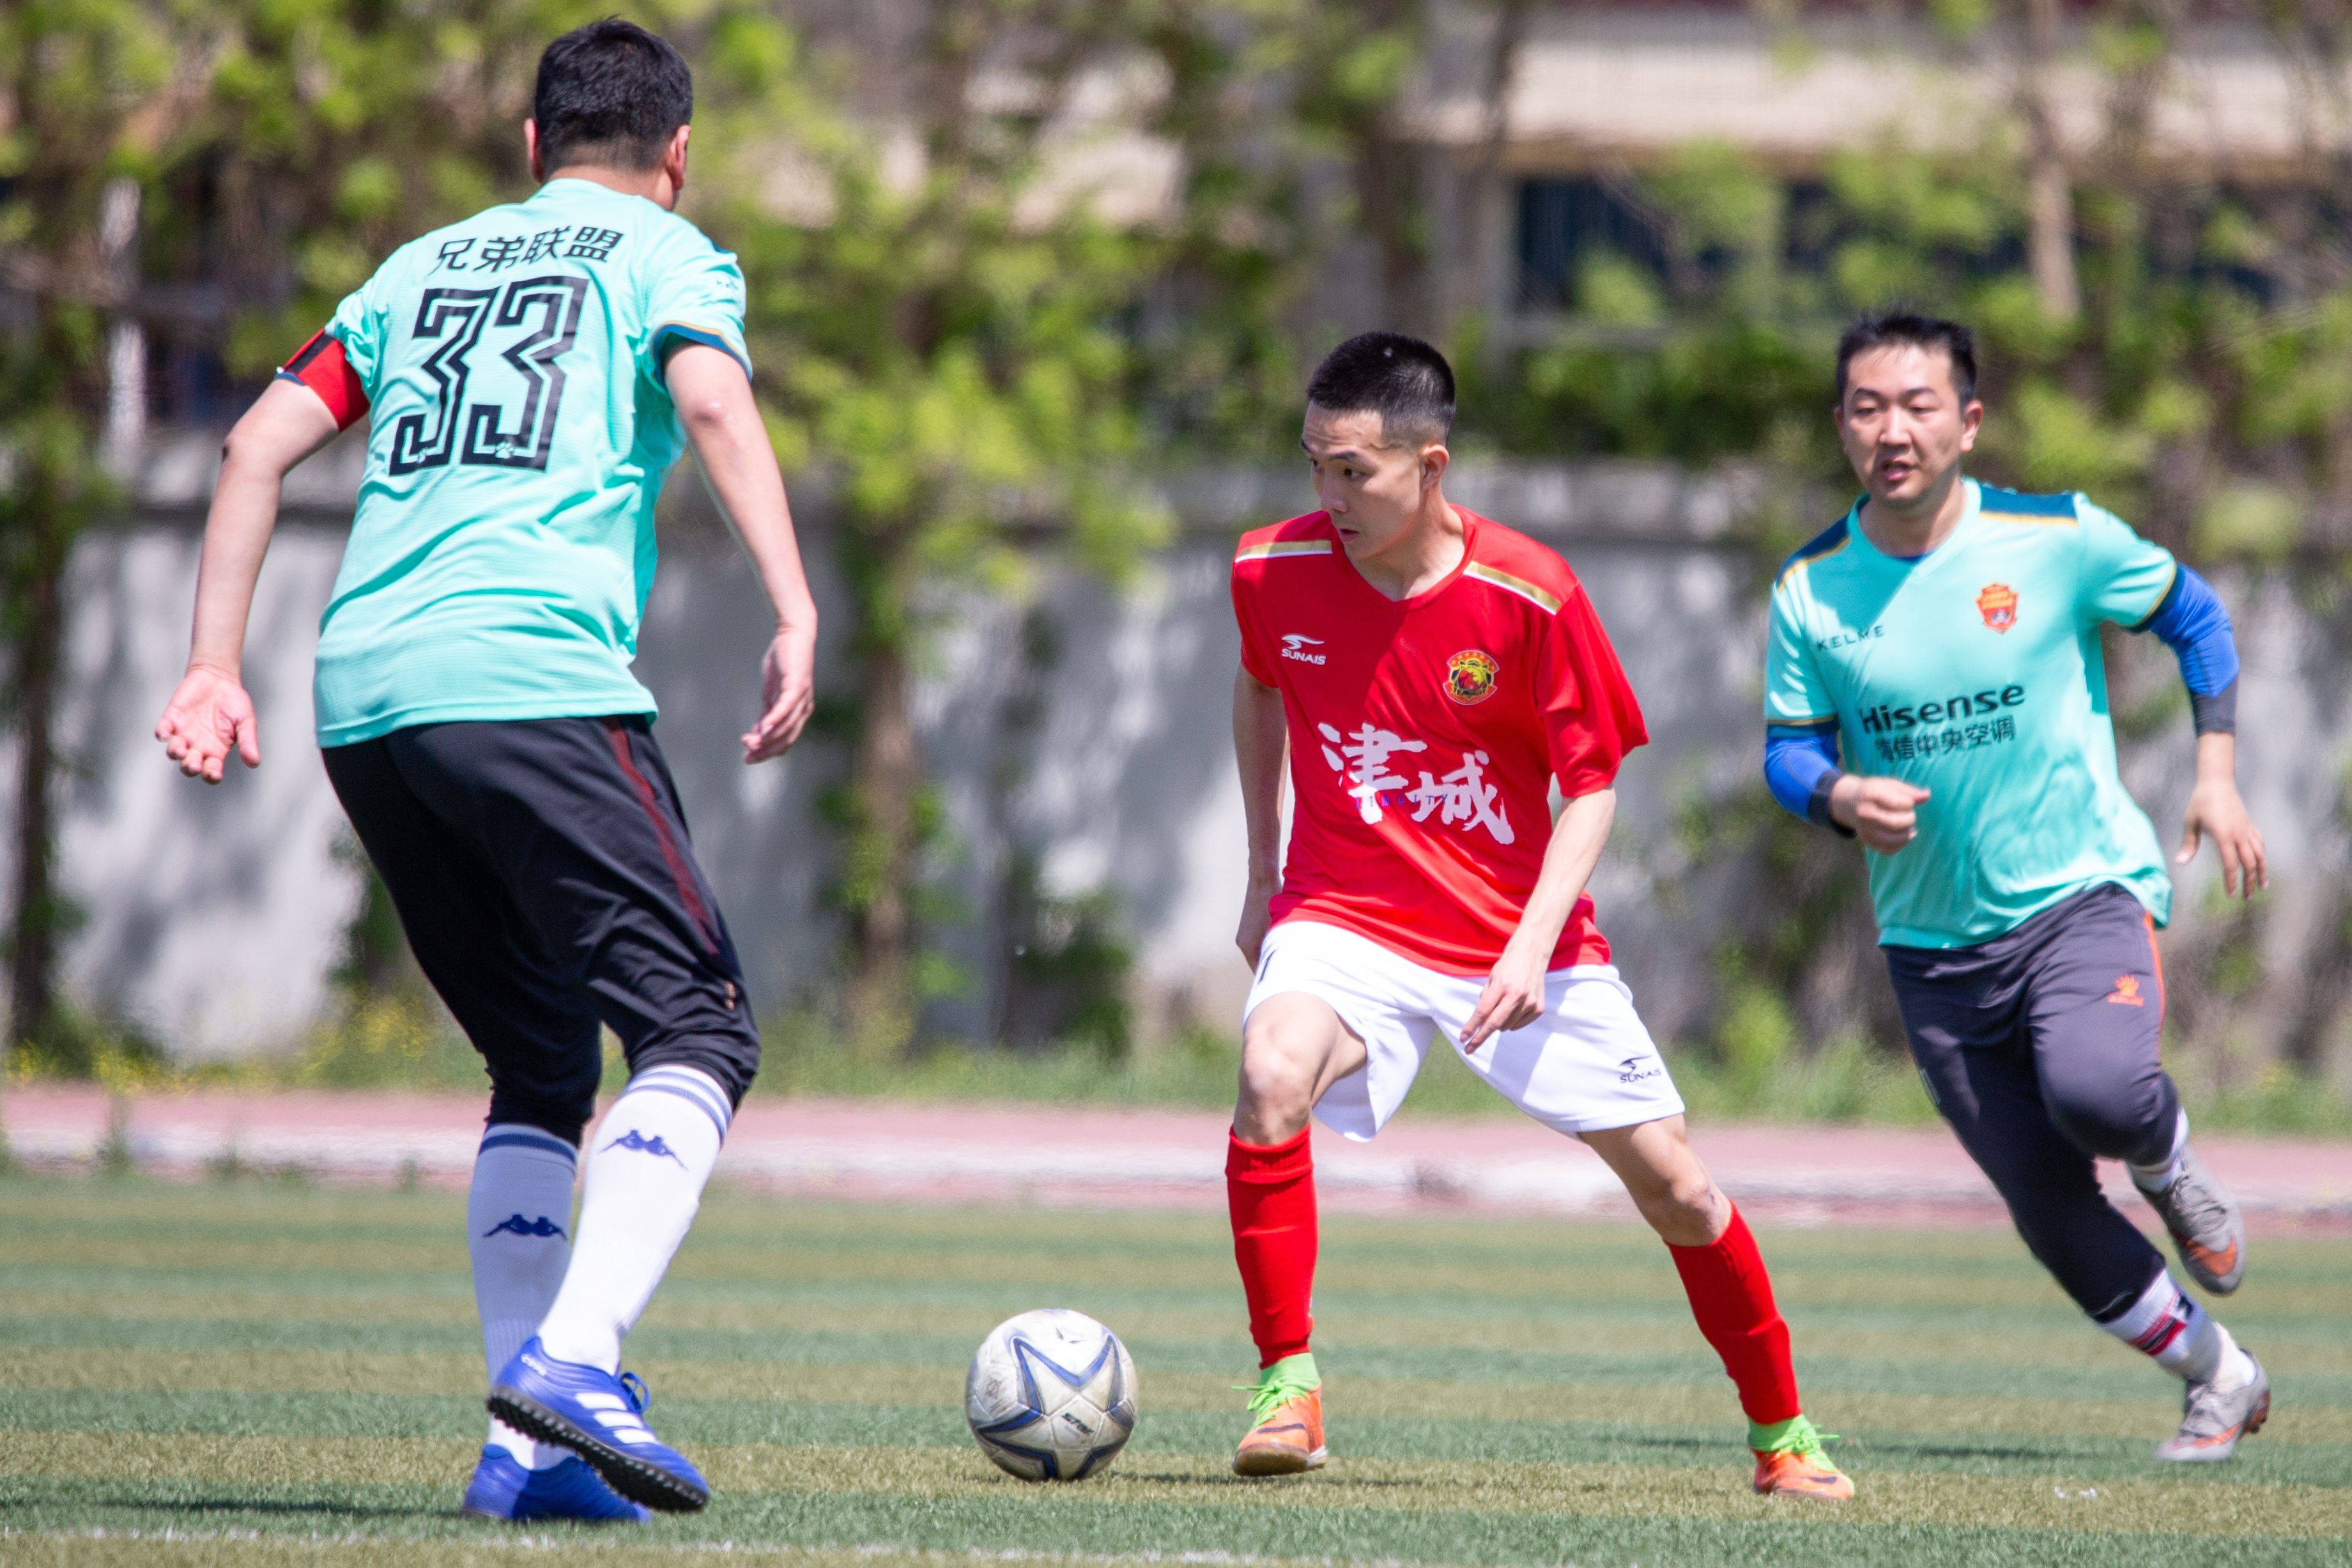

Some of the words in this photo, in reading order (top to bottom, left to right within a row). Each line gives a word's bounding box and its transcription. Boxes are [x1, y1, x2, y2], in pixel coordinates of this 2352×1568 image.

[426, 226, 625, 277] 兄弟联盟
[389, 275, 589, 476] 33
[1280, 647, 1326, 666] SUNAIS
[1816, 625, 1886, 651] KELME
[1859, 684, 2025, 735] Hisense
[1318, 722, 1515, 845] 津城
